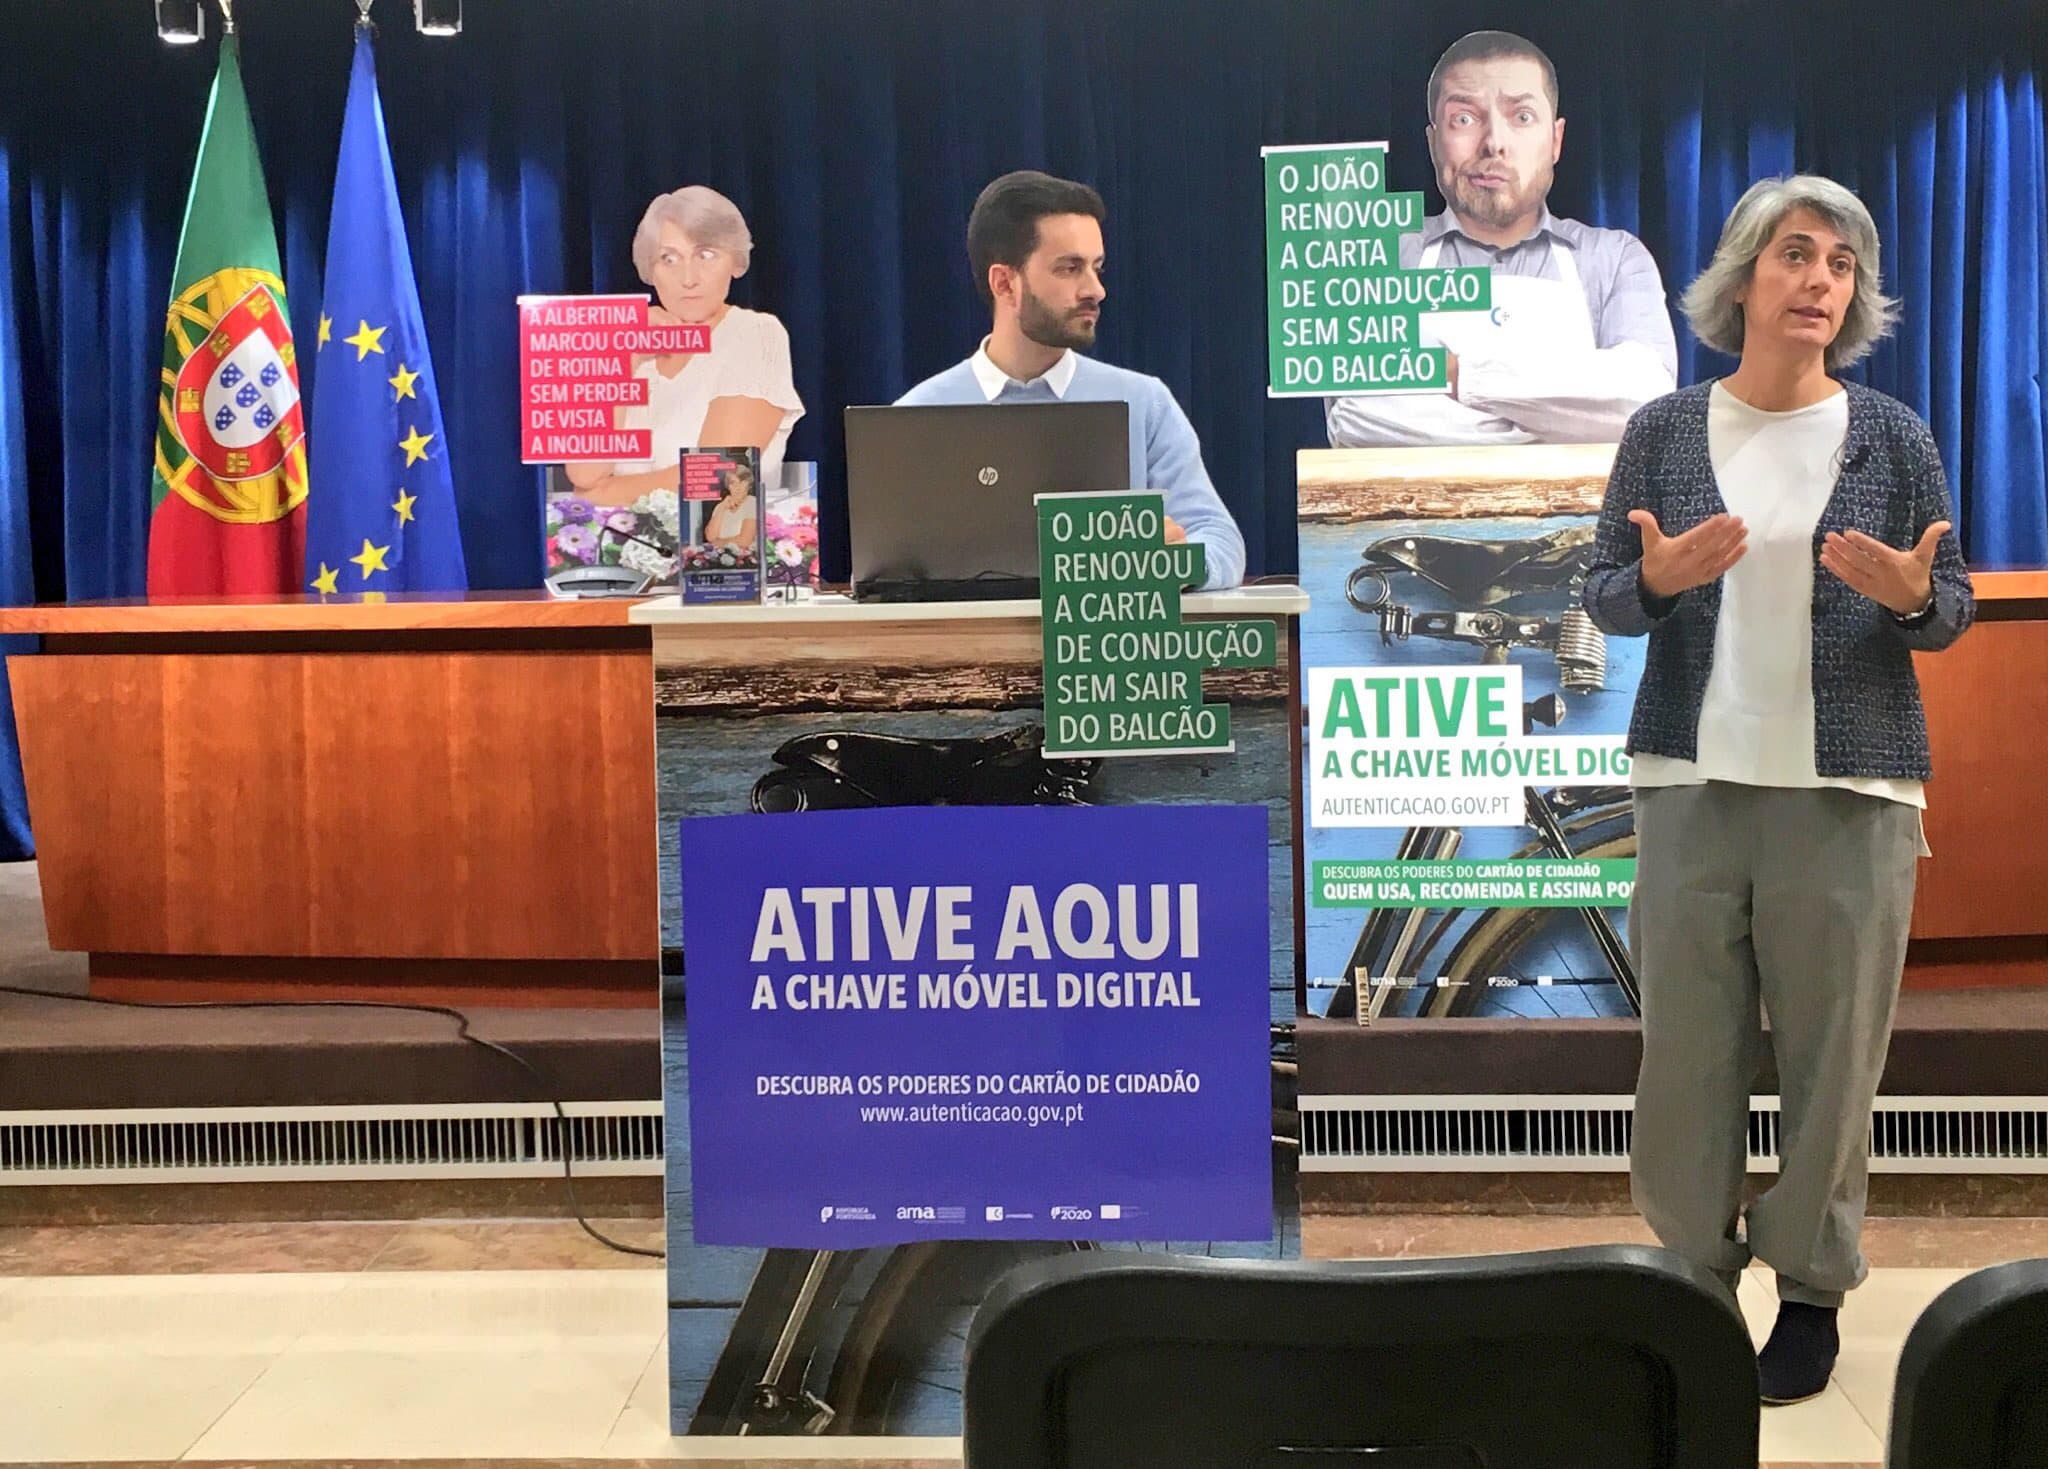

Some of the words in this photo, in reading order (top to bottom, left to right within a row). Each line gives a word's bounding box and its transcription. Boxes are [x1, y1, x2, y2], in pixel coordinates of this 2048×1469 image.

[1279, 165, 1298, 192] O
[1306, 157, 1379, 192] JOÃO
[1281, 199, 1411, 231] RENOVOU
[1280, 243, 1298, 269] A
[1305, 239, 1387, 268] CARTA
[1283, 280, 1315, 308] DE
[1324, 269, 1479, 310] CONDUÇÃO
[529, 307, 541, 325] A
[545, 306, 638, 325] ALBERTINA
[530, 332, 608, 351] MARCOU
[613, 329, 704, 350] CONSULTA
[1283, 318, 1338, 346] SEM
[1347, 316, 1407, 344] SAIR
[531, 359, 553, 377] DE
[559, 357, 622, 376] ROTINA
[1285, 356, 1323, 384] DO
[1333, 348, 1434, 383] BALCÃO
[531, 384, 568, 403] SEM
[574, 383, 640, 402] PERDER
[531, 410, 553, 428] DE
[558, 409, 606, 428] VISTA
[531, 436, 544, 454] A
[548, 435, 639, 453] INQUILINA
[978, 467, 998, 485] hp
[1052, 513, 1073, 541] O
[1080, 504, 1157, 541] JOÃO
[1054, 550, 1191, 582] RENOVOU
[1054, 595, 1073, 623] A
[1080, 592, 1166, 622] CARTA
[1057, 634, 1092, 663] DE
[1101, 623, 1263, 666] CONDUÇÃO
[1057, 674, 1115, 704] SEM
[1125, 672, 1188, 701] SAIR
[1322, 677, 1507, 738] ATIVE
[1060, 715, 1099, 743] DO
[1110, 705, 1216, 742] BALCÃO
[1322, 750, 1342, 778] A
[1351, 750, 1450, 778] CHAVE
[1462, 741, 1568, 777] MÓVEL
[1322, 797, 1510, 816] AUTENTICACAO.GOV.PT
[1323, 866, 1381, 879] DESCUBRA
[1384, 866, 1399, 879] OS
[1402, 865, 1453, 878] PODERES
[1456, 866, 1473, 878] DO
[1476, 863, 1524, 878] CARTÃO
[1527, 865, 1543, 877] DE
[1545, 863, 1600, 877] CIDADÃO
[1323, 884, 1373, 901] QUEM
[1378, 883, 1416, 901] USA,
[1420, 883, 1525, 900] RECOMENDA
[1529, 883, 1538, 898] E
[1542, 882, 1603, 898] ASSINA
[750, 886, 975, 962] ATIVE
[995, 883, 1198, 961] AQUI
[751, 975, 776, 1010] A
[785, 974, 906, 1009] CHAVE
[918, 965, 1047, 1009] MÓVEL
[1057, 972, 1201, 1007] DIGITAL
[757, 1075, 853, 1096] DESCUBRA
[858, 1075, 883, 1094] OS
[888, 1074, 971, 1094] PODERES
[976, 1075, 1003, 1094] DO
[1008, 1070, 1080, 1094] CARTÃO
[1086, 1074, 1110, 1094] DE
[1115, 1070, 1199, 1093] CIDADÃO
[860, 1101, 1083, 1126] www.autenticacao.gov.pt
[896, 1206, 936, 1219] ama
[1060, 1209, 1092, 1220] 2020
